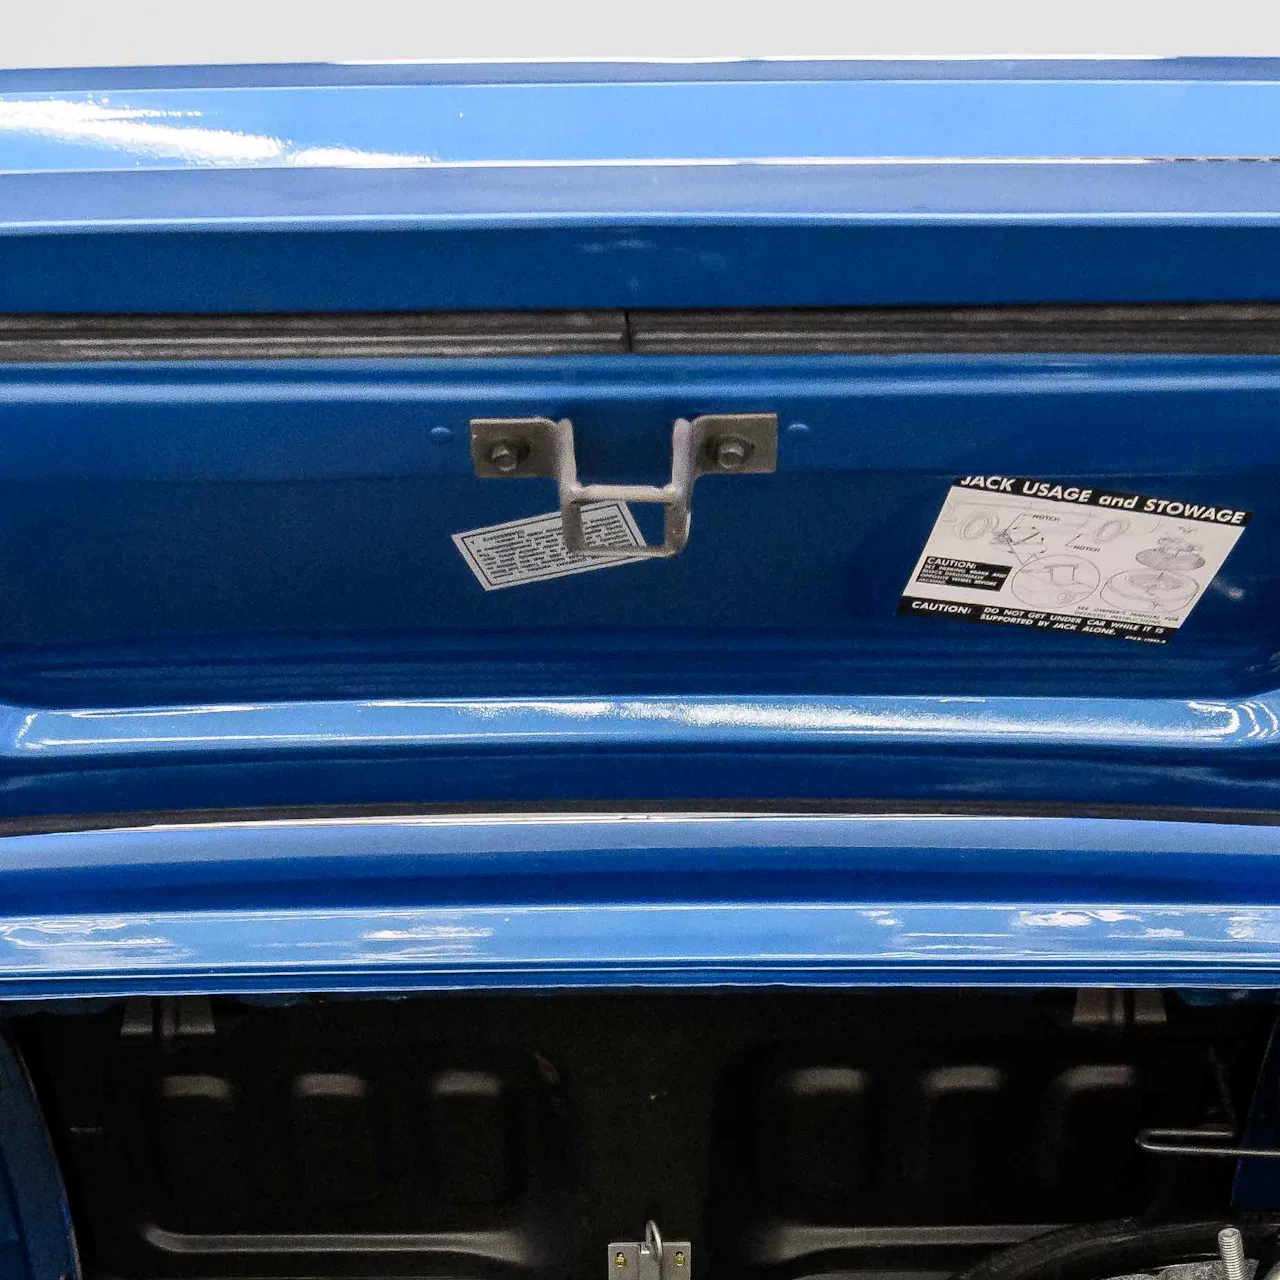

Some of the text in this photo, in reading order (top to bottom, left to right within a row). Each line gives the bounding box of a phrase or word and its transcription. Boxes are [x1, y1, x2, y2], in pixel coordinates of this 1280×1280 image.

[960, 476, 1246, 524] JACK USAGE and STOWAGE
[927, 557, 977, 569] CAUTION:
[912, 601, 972, 615] CAUTION:
[983, 606, 999, 614] DO
[1003, 609, 1025, 617] NOT
[1028, 612, 1047, 620] GET
[1049, 615, 1083, 624] UNDER
[1087, 619, 1106, 627] CAR
[1111, 622, 1140, 631] WHILE
[980, 613, 1033, 626] SUPPORTED
[1037, 620, 1050, 628] BY
[1052, 622, 1078, 631] JACK
